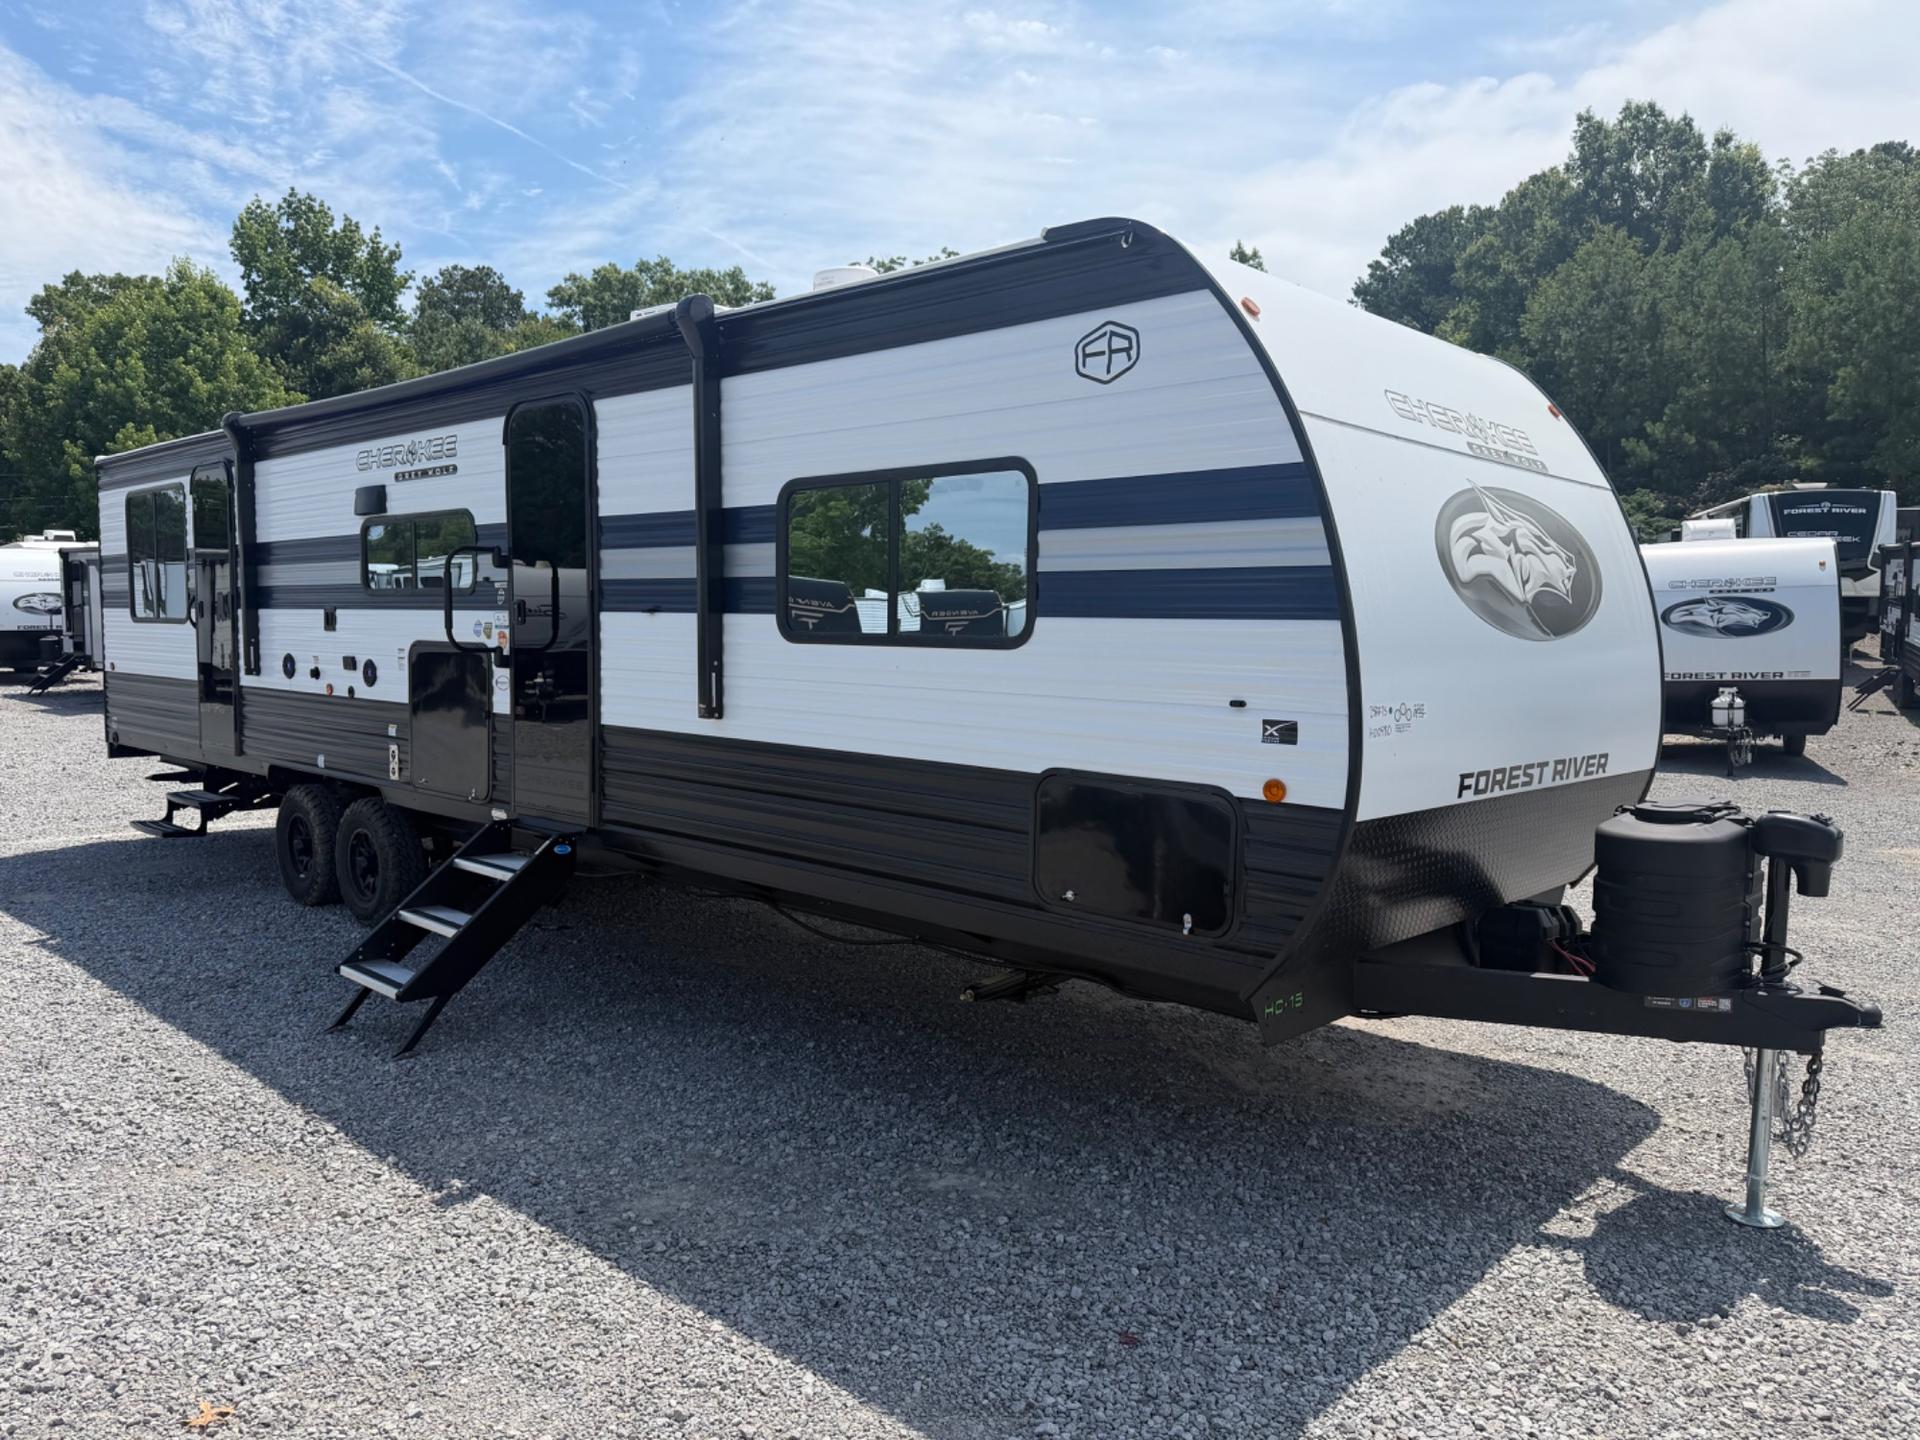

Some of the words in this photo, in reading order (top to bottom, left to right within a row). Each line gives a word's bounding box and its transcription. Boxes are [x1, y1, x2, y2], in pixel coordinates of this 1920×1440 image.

[1383, 389, 1539, 457] CHEROKEE
[356, 434, 458, 472] CHEROKEE
[1668, 576, 1777, 589] CHEROKEE
[1731, 671, 1784, 680] RIVER
[1457, 761, 1549, 799] FOREST
[1551, 752, 1609, 783] RIVER
